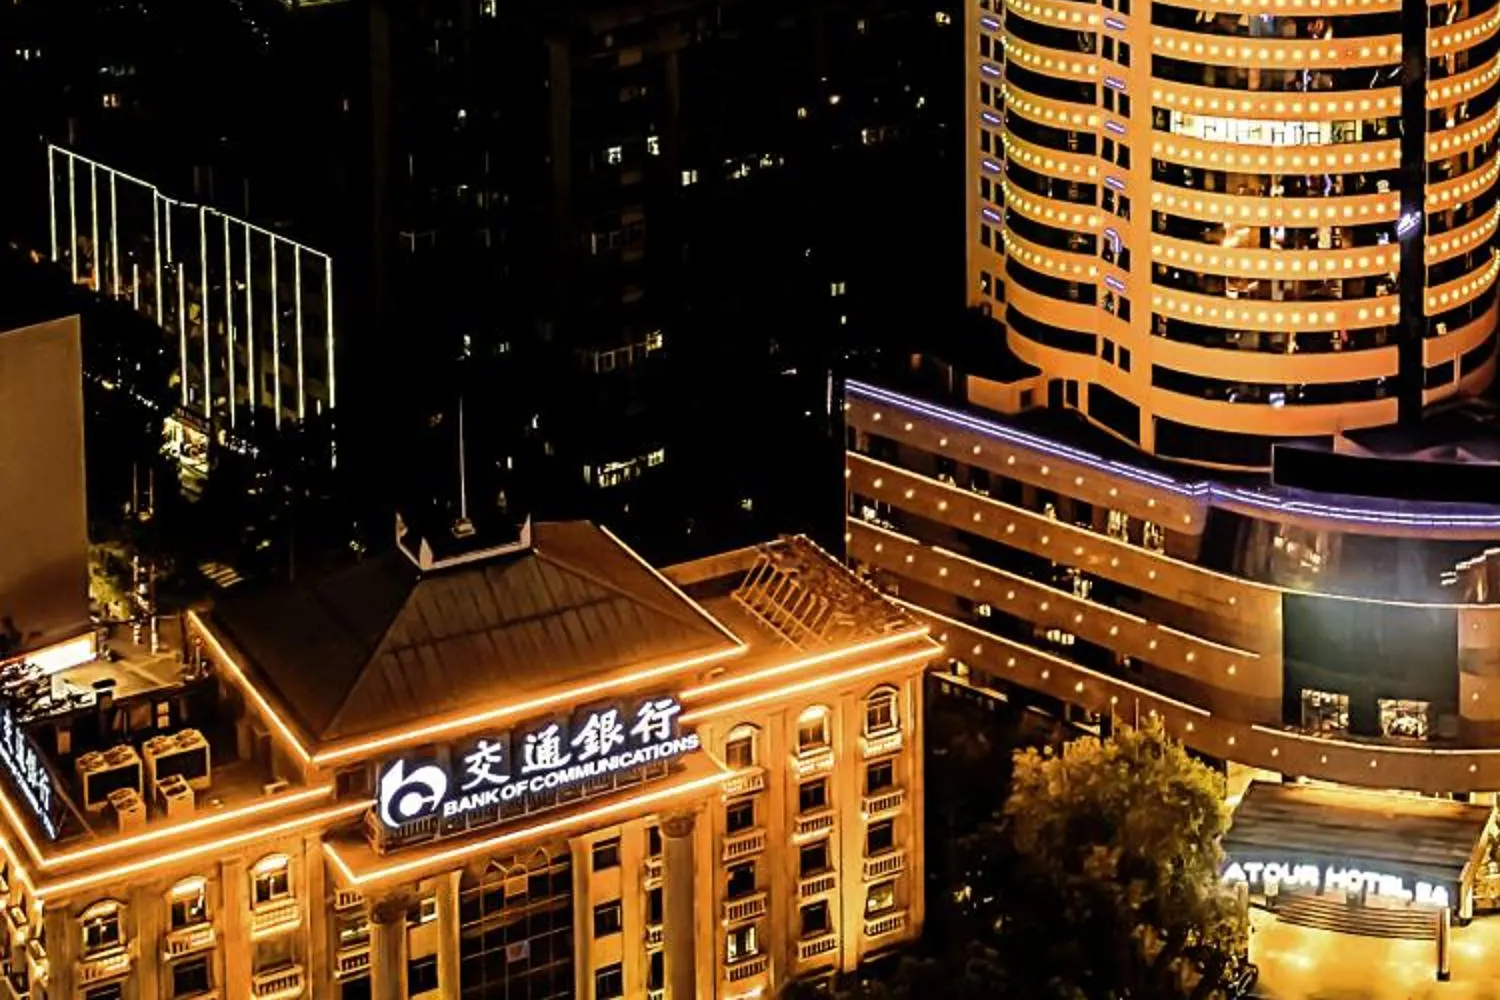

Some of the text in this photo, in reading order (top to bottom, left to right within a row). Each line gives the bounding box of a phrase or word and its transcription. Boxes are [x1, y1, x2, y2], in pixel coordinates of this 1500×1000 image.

[443, 734, 700, 817] BANK OF COMMUNICATIONS
[461, 698, 681, 789] 交通銀行
[1222, 861, 1319, 888] ATOUR
[1326, 863, 1413, 899] HOTEL
